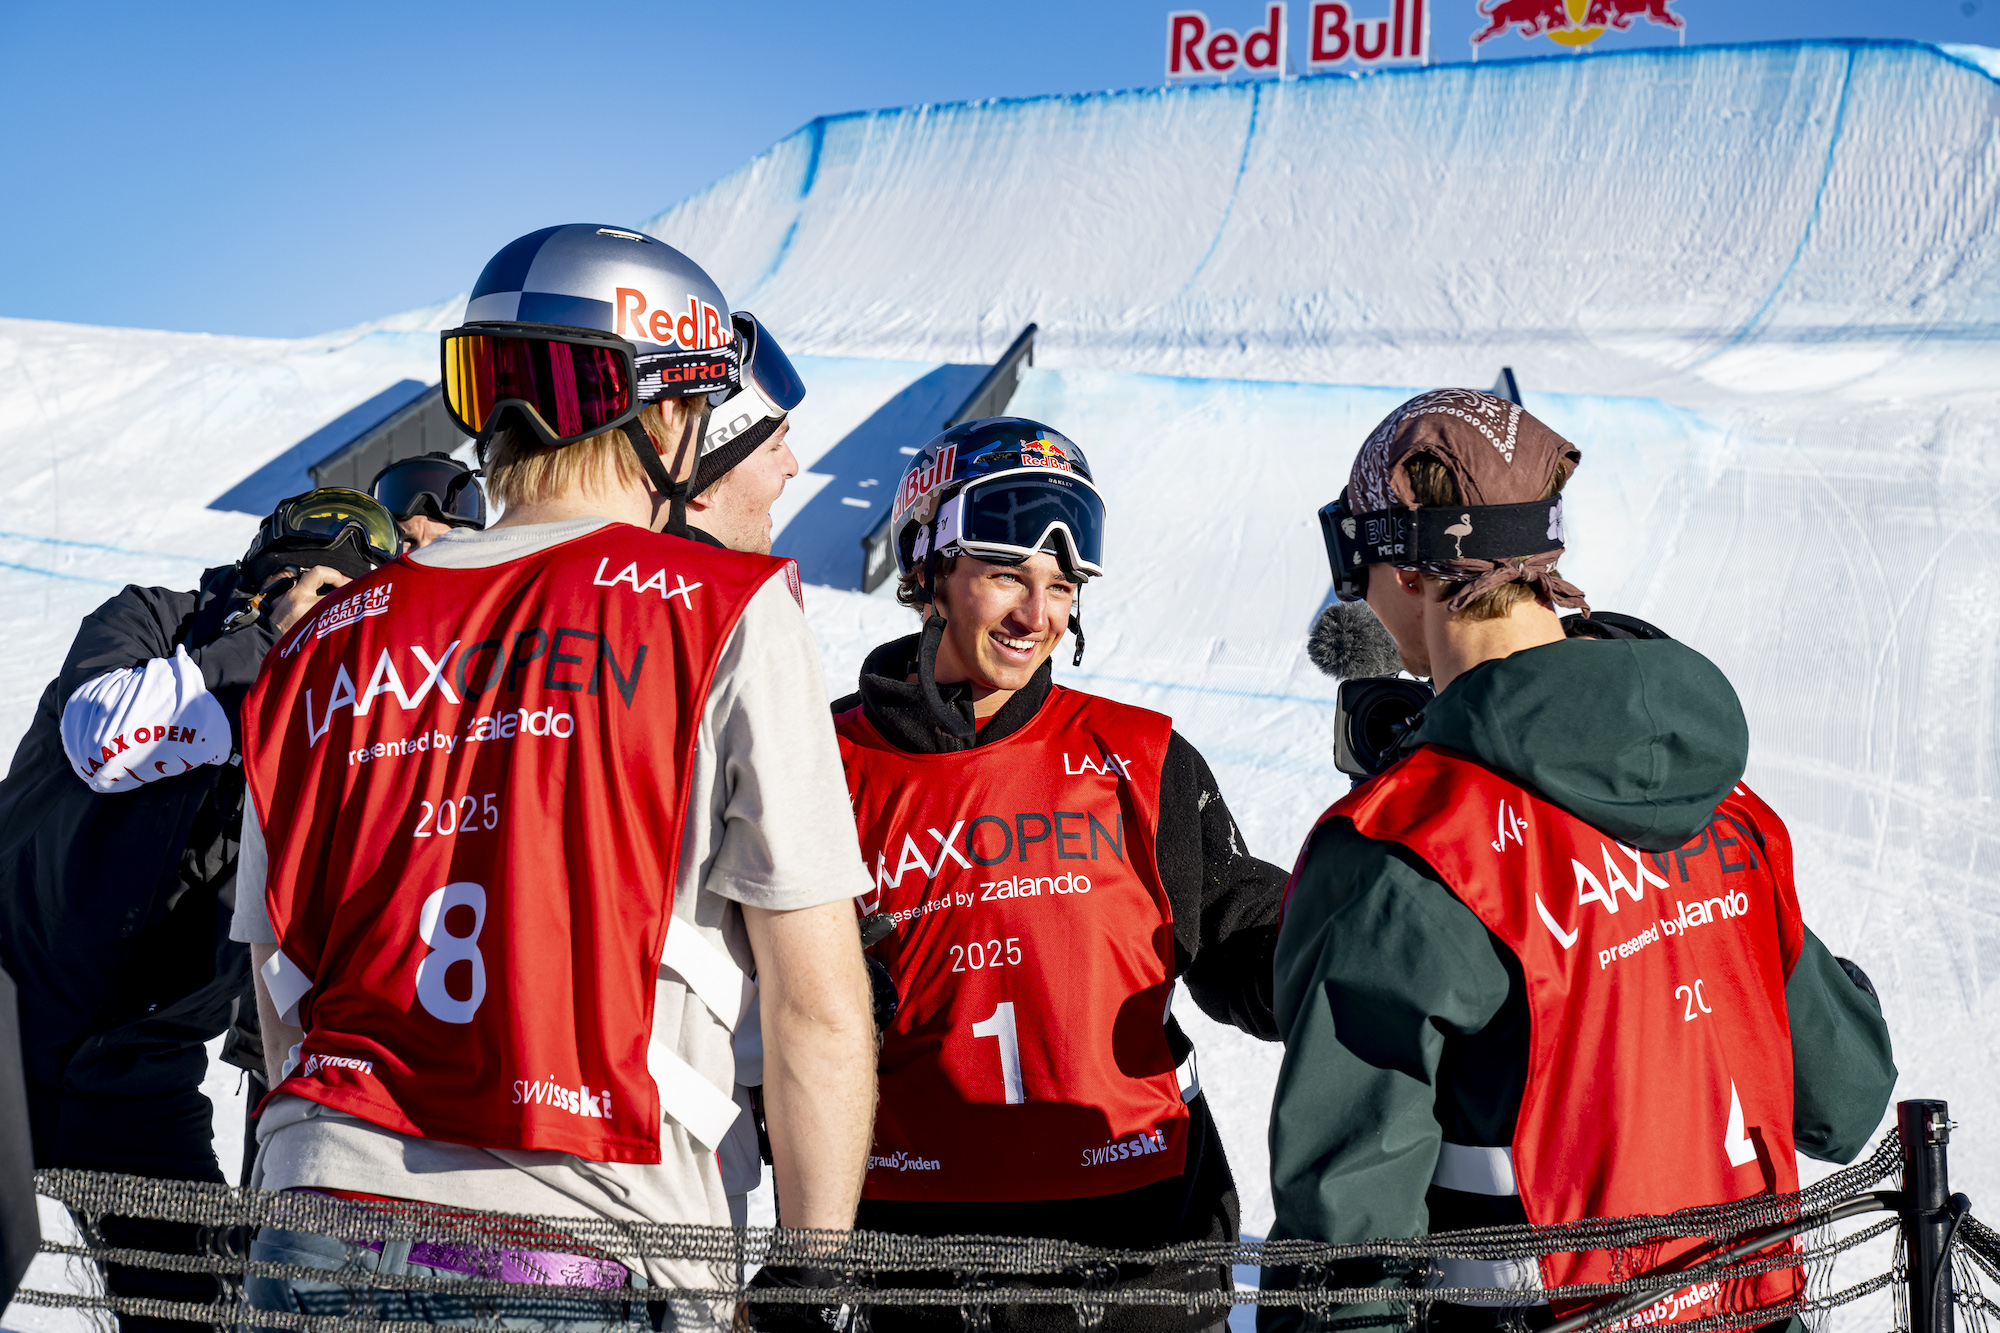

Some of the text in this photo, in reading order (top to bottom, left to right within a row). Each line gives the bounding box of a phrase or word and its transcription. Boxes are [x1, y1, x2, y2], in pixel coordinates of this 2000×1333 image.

[1169, 0, 1422, 73] Red Bull
[615, 287, 698, 350] Red
[661, 362, 726, 383] GIRO
[702, 413, 752, 454] RO
[904, 446, 956, 509] Bull
[1022, 455, 1072, 473] Red Bull
[1048, 477, 1073, 488] OAKLEY
[320, 583, 393, 621] FREESKI
[593, 557, 703, 610] LAAX
[318, 595, 390, 629] WORLD CUP
[80, 733, 131, 778] LAAX
[134, 725, 197, 744] OPEN
[432, 729, 458, 754] by
[1063, 752, 1132, 781] LAAX
[413, 793, 499, 838] 2025
[955, 891, 975, 907] by
[980, 871, 1091, 902] zalando
[1660, 919, 1684, 936] by
[1676, 889, 1748, 929] lando
[415, 881, 487, 1024] 8
[949, 937, 1022, 973] 2025
[972, 1001, 1024, 1104] 1
[512, 1073, 613, 1120] swissski
[1081, 1129, 1167, 1167] swissski
